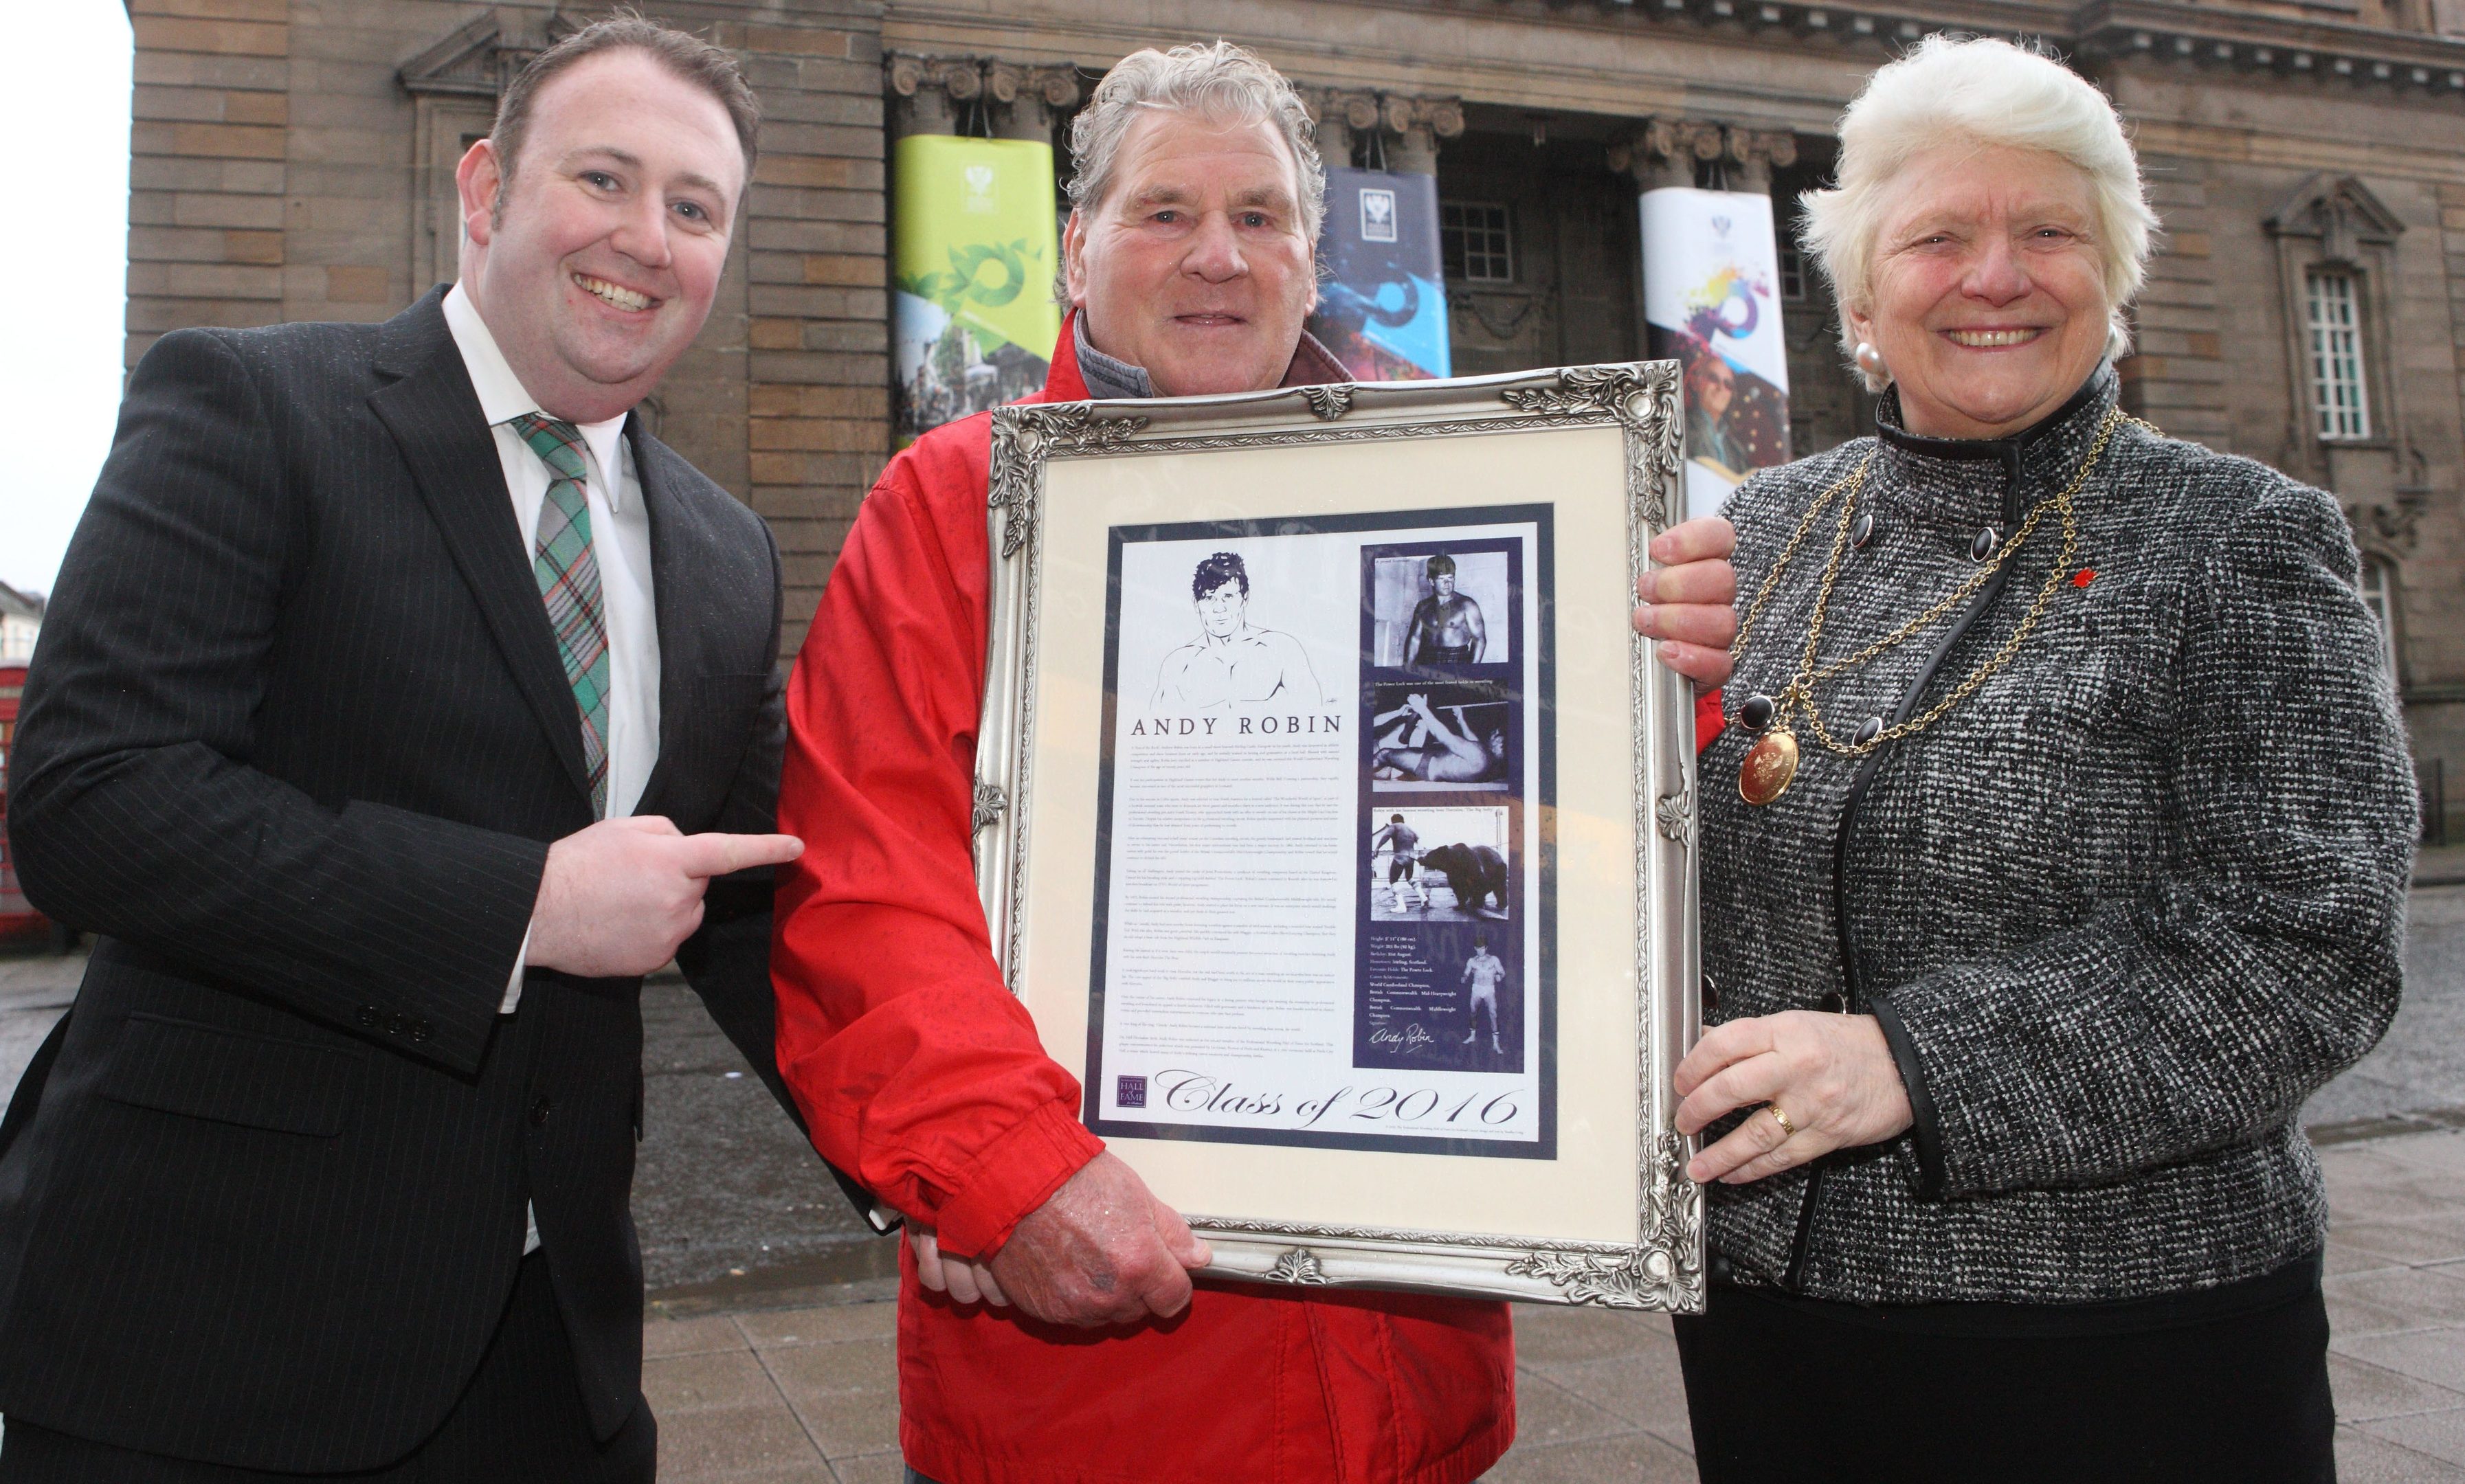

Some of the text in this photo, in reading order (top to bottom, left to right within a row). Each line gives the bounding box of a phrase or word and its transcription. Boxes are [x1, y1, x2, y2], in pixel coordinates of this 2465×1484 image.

[1130, 715, 1341, 736] ANDY ROBIN
[1368, 1023, 1435, 1053] Andy Robin
[1120, 1082, 1144, 1090] HALL
[1120, 1093, 1144, 1101] FAME
[1155, 1070, 1526, 1131] Class of 2016
